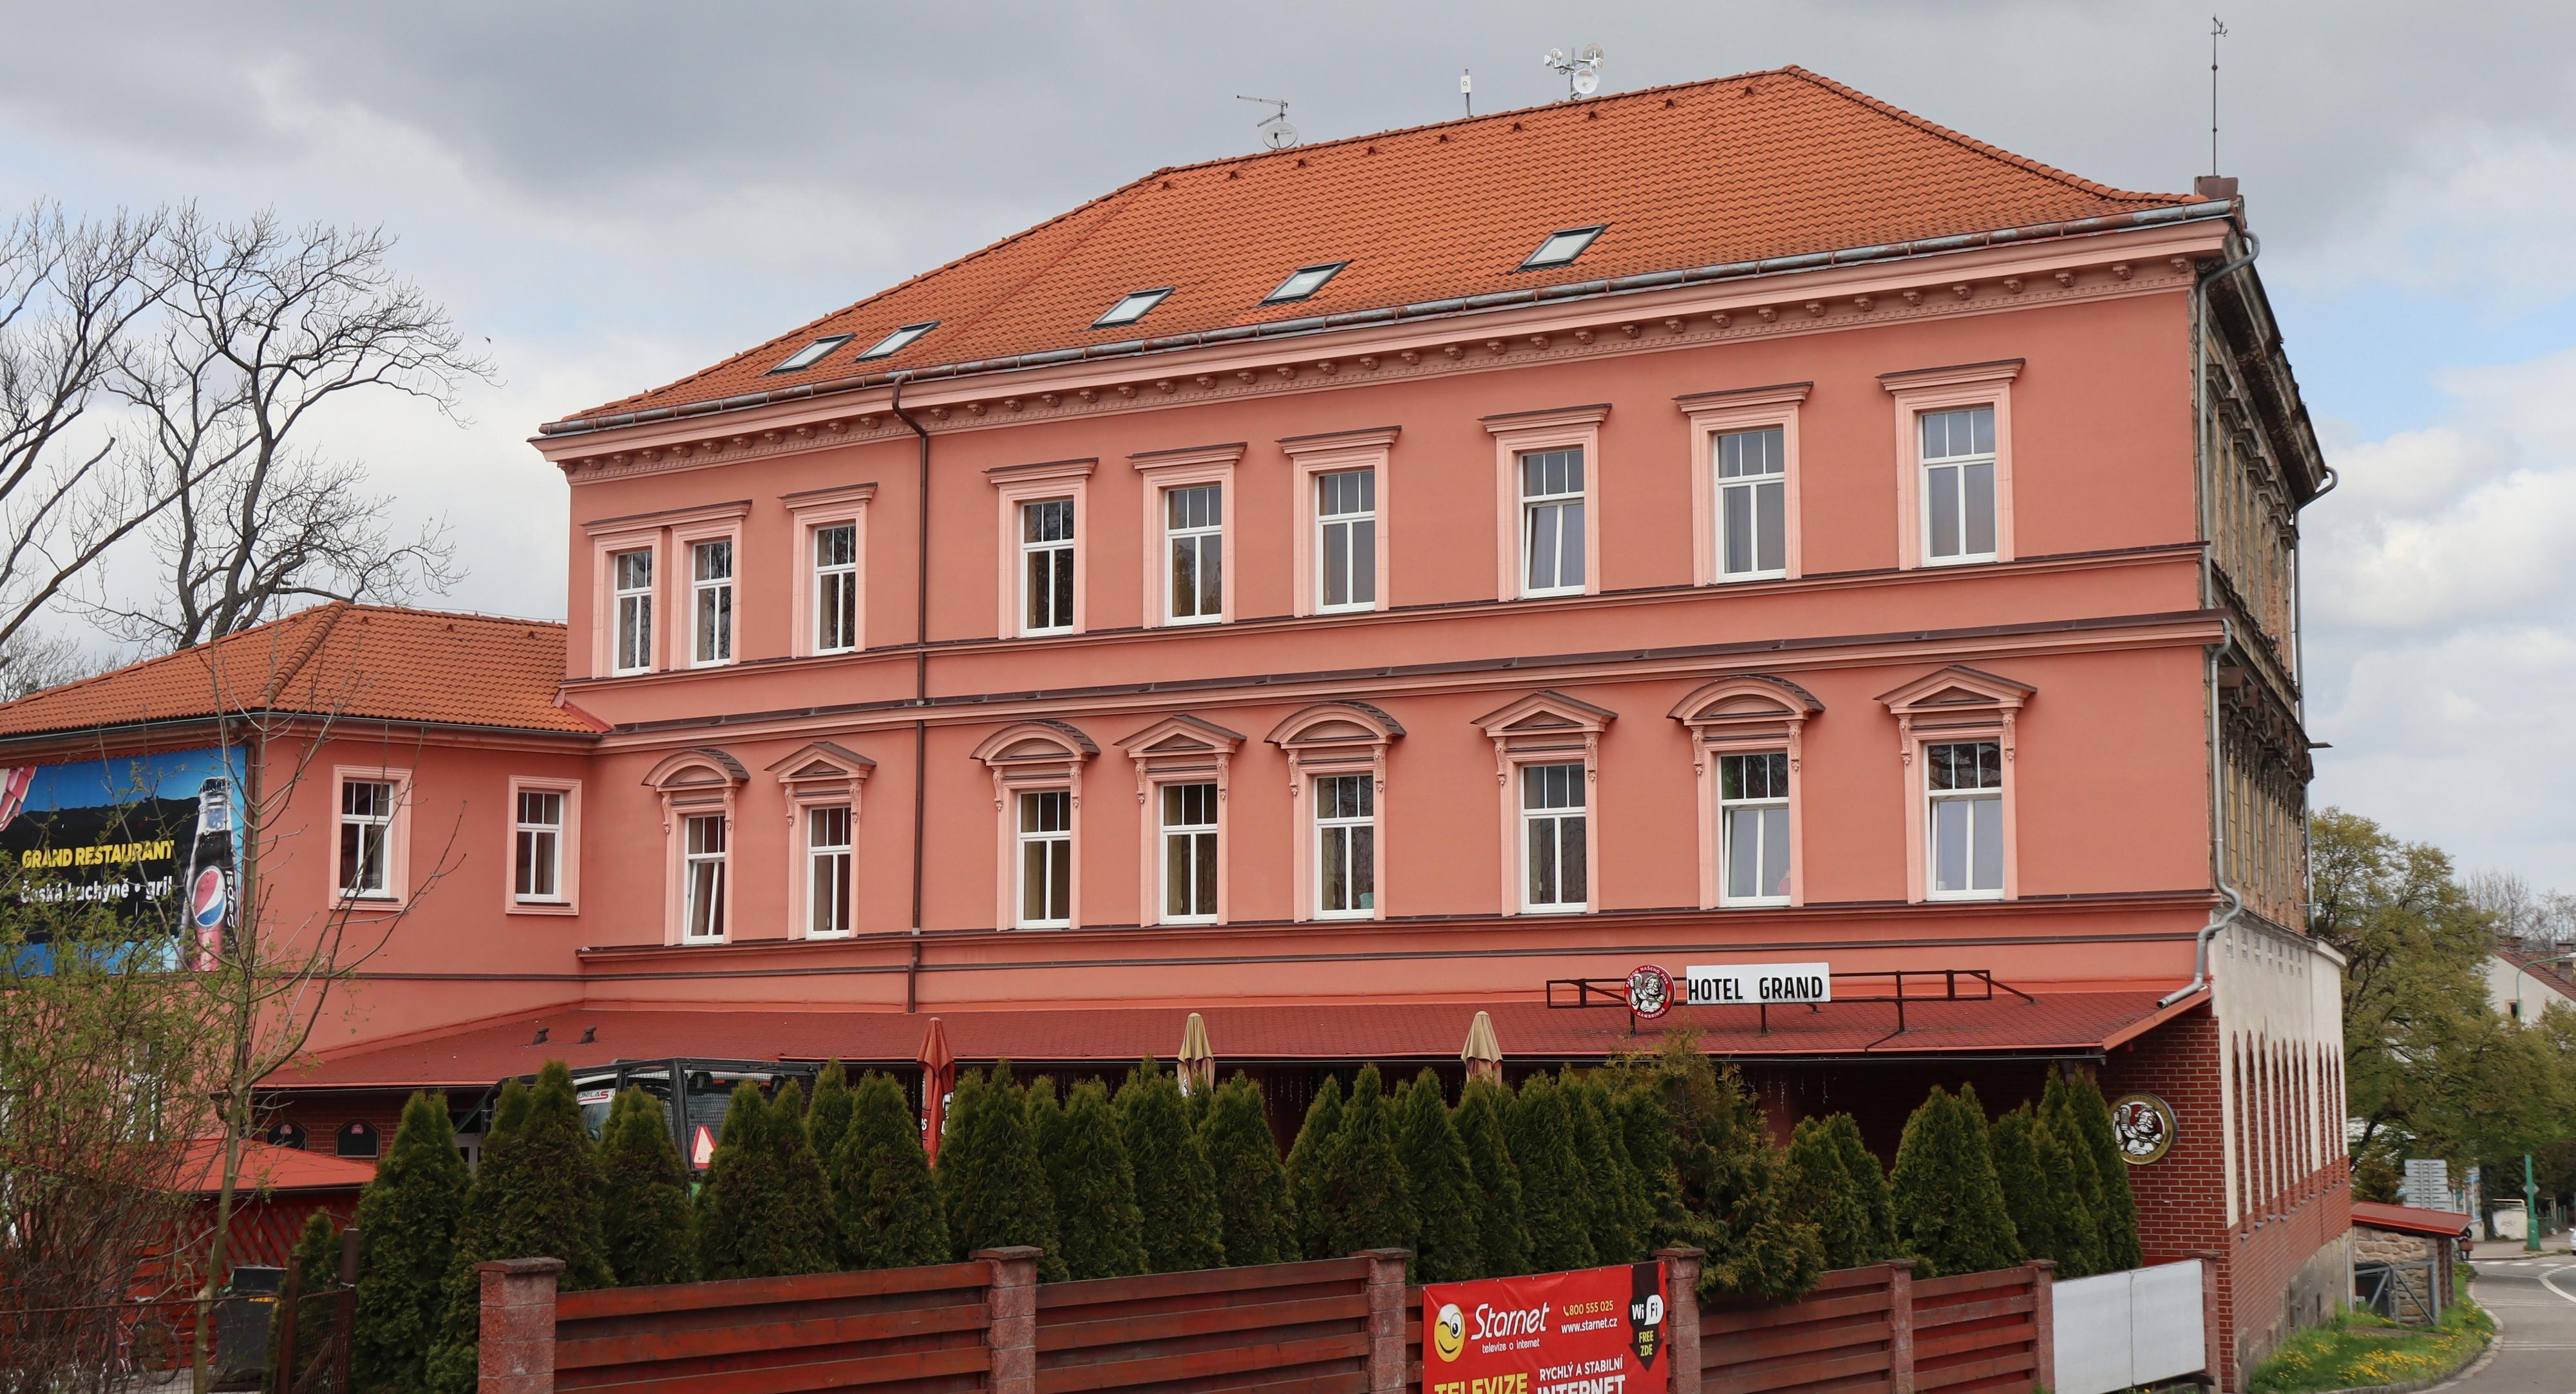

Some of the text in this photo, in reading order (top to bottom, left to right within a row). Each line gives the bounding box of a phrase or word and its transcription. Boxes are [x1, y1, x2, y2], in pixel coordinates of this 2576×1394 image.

[22, 840, 175, 869] GRAND RESTAURANT
[146, 876, 172, 900] gril
[1640, 966, 1660, 974] NAŠEHO
[1660, 974, 1669, 985] PIVA
[1688, 977, 1823, 1000] HOTEL GRAND
[1637, 1007, 1665, 1019] GAMBRINUS
[1569, 1300, 1613, 1315] 800 555 025
[1470, 1301, 1550, 1341] Starnet
[1561, 1317, 1618, 1334] www.starnet.cz
[1482, 1342, 1506, 1353] televize
[1517, 1337, 1540, 1349] internet
[1639, 1330, 1654, 1343] FREE
[1640, 1344, 1653, 1357] ZDE
[1540, 1353, 1623, 1382] RYCHLÝ A STABILNÍ
[1537, 1374, 1625, 1394] RNET
